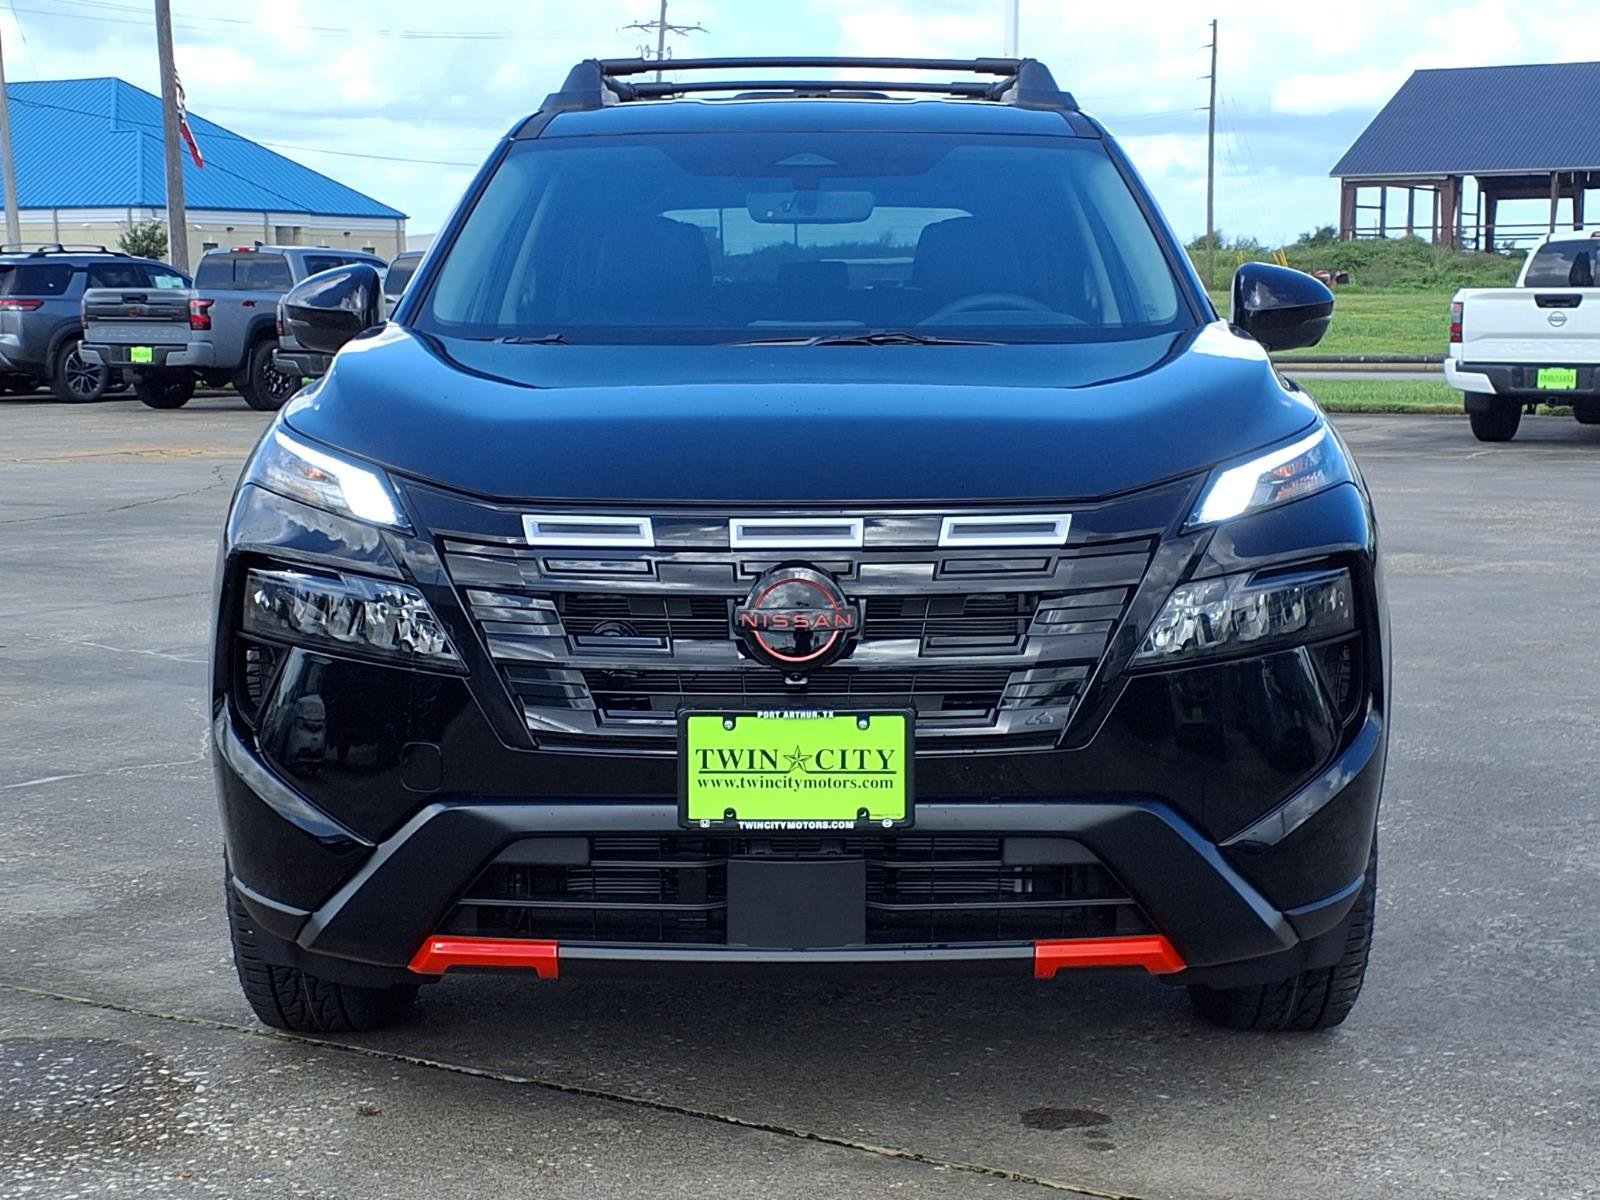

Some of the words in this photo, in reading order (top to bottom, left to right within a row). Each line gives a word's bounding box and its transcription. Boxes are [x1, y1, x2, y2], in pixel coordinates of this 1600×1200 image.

[741, 613, 852, 628] NISSAN
[757, 710, 781, 719] PORT
[822, 710, 834, 719] TX
[695, 748, 779, 770] TWIN
[814, 748, 896, 770] CITY
[697, 775, 894, 792] www.twincitymotors.com
[738, 820, 855, 830] TWINCITYMOTORS.COM
